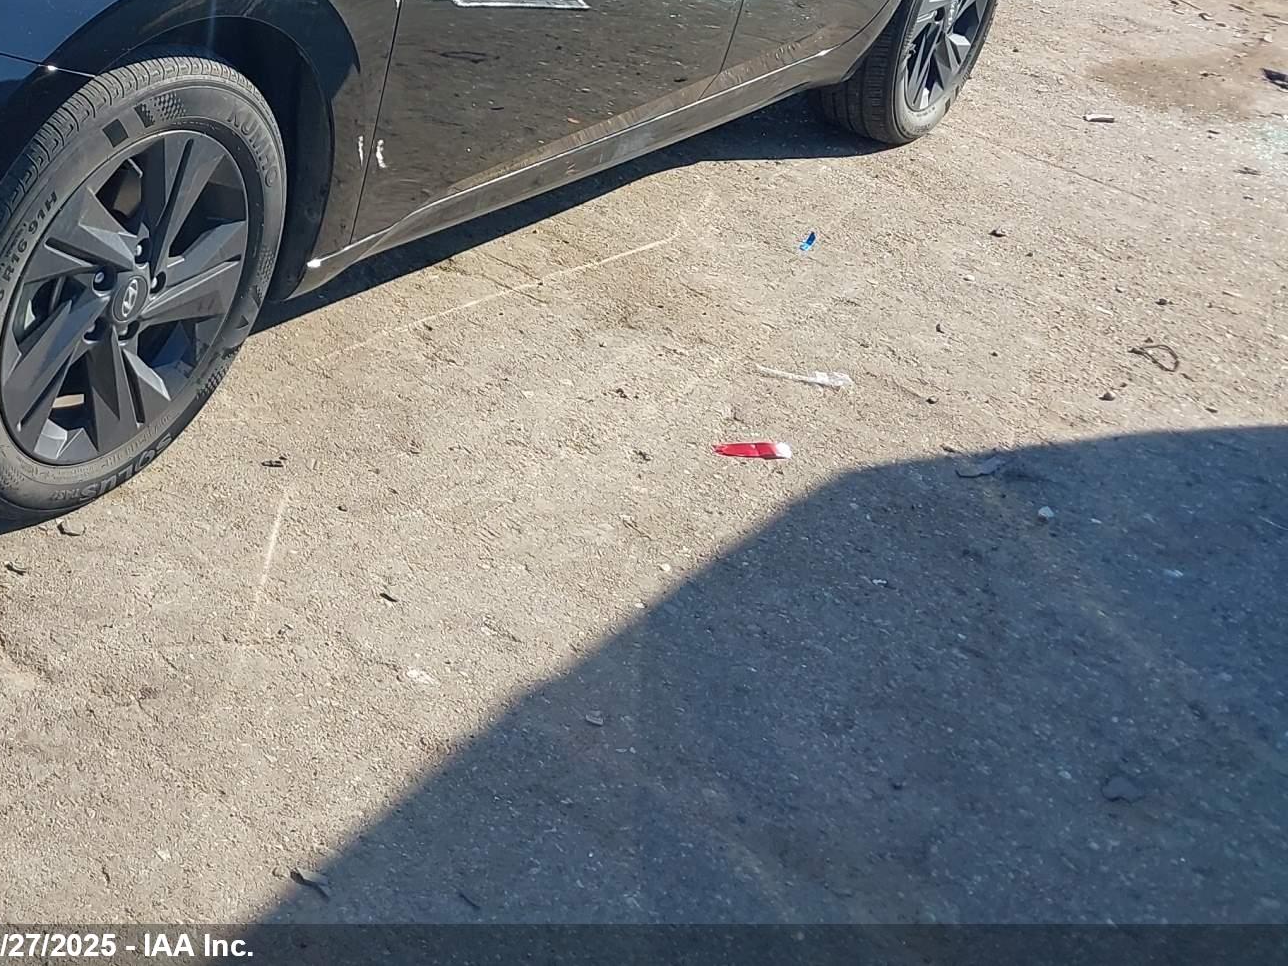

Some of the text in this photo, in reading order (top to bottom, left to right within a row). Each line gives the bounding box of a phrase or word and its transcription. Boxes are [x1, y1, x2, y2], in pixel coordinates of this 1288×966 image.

[227, 108, 279, 188] KUMHO
[2, 239, 28, 282] R16
[28, 191, 58, 235] 91H
[80, 433, 172, 502] SOLUS
